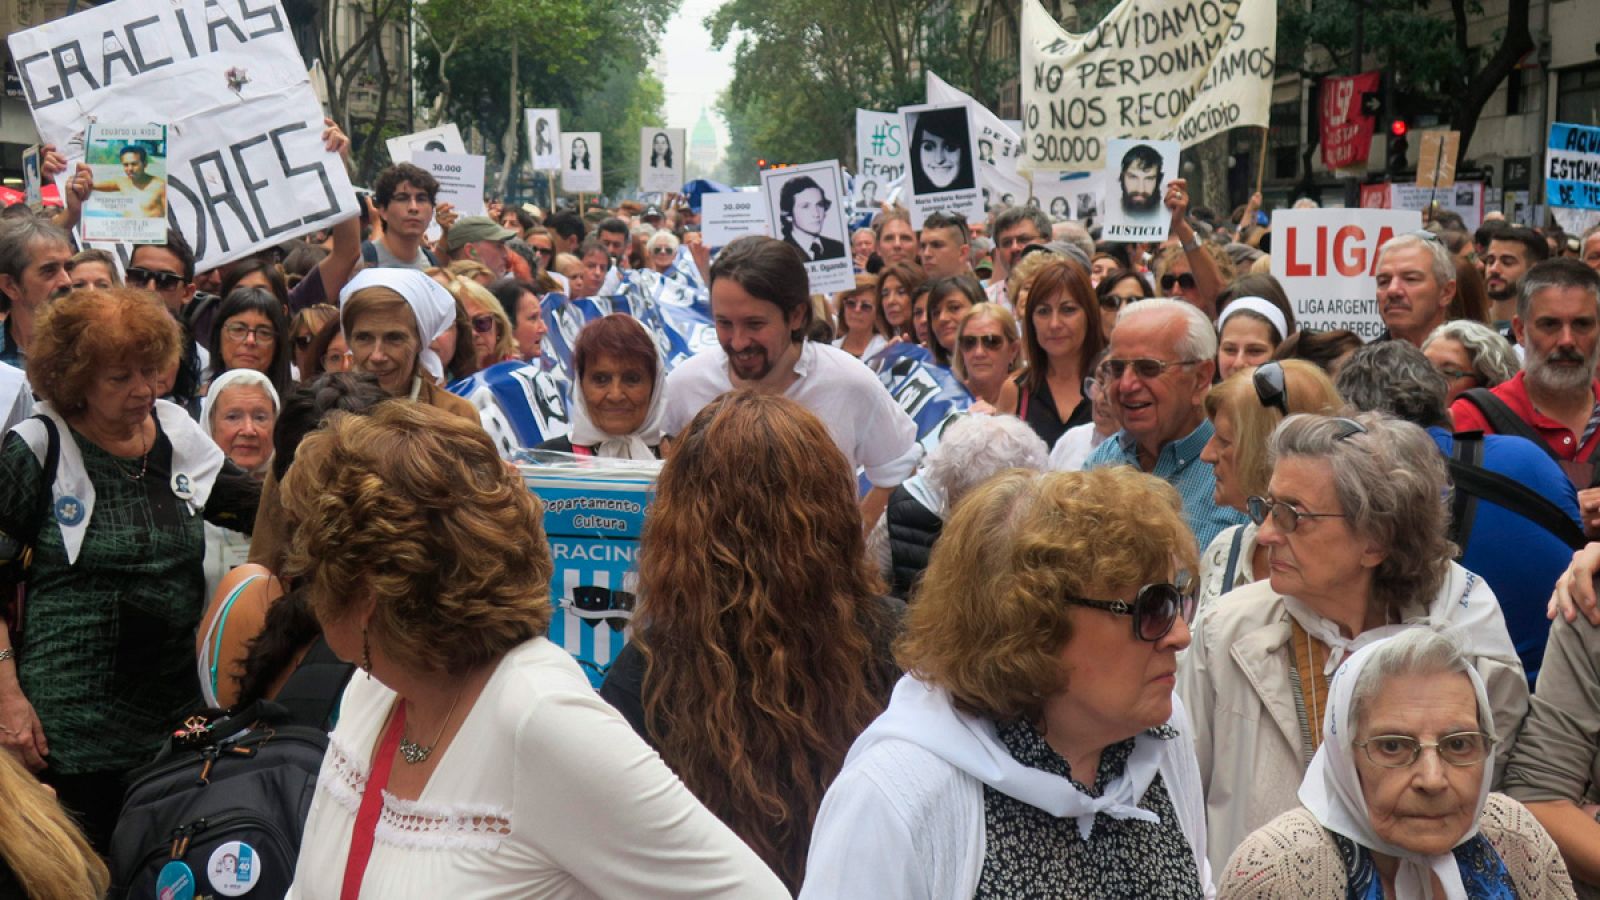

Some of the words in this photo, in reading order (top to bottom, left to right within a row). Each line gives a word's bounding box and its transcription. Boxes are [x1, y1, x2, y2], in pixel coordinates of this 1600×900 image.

[15, 0, 283, 110] GRACIAS
[1034, 61, 1063, 93] NO
[1076, 22, 1245, 89] PERDONAMS
[1049, 95, 1107, 131] NOS
[1032, 133, 1101, 163] 30.000
[1108, 224, 1163, 236] JUSTICIA
[1298, 299, 1325, 314] LIGA
[1326, 298, 1379, 315] ARGENTI
[1340, 321, 1388, 338] DERECH
[573, 514, 627, 531] Cultura
